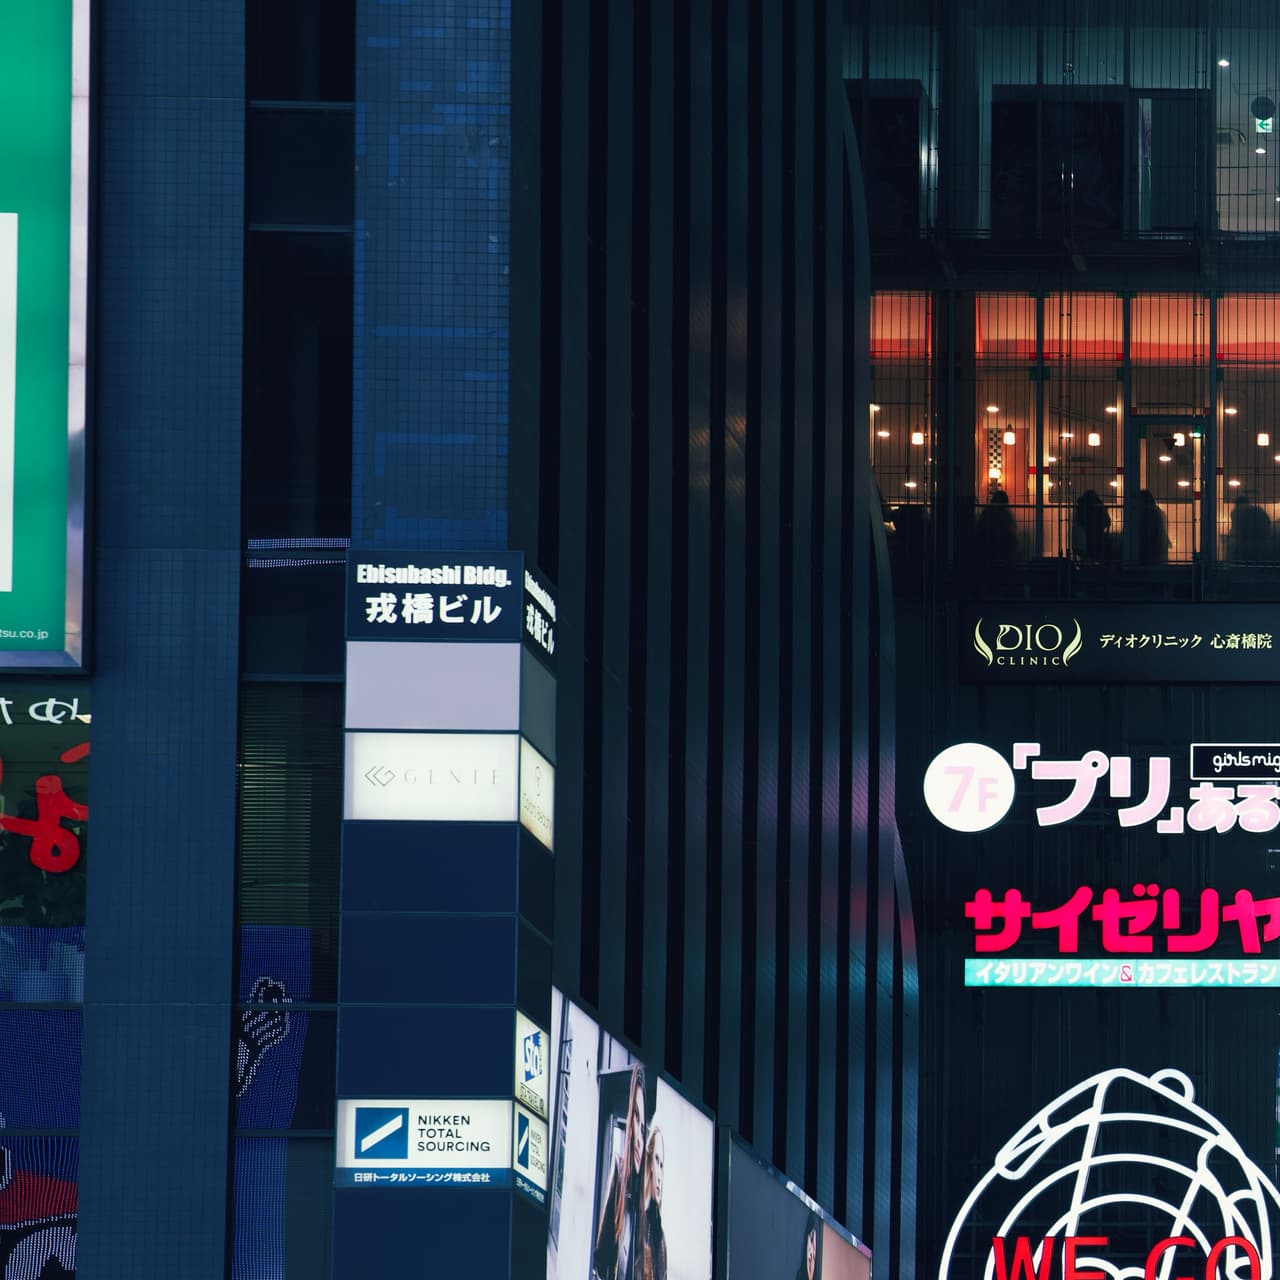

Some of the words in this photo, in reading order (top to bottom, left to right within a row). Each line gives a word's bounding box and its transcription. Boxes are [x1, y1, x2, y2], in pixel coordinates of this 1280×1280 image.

[356, 564, 461, 585] Ebisubashi
[463, 565, 512, 588] Bldg.
[365, 592, 502, 624] 戎橋ビル
[996, 624, 1063, 651] DIO
[1100, 632, 1203, 649] ディオクリニック
[1210, 632, 1273, 649] 心斎橋院
[996, 656, 1062, 666] CLINIC
[944, 765, 999, 813] 7F
[417, 1115, 471, 1126] NIKKEN
[417, 1128, 463, 1139] TOTAL
[416, 1141, 491, 1152] SOURCING
